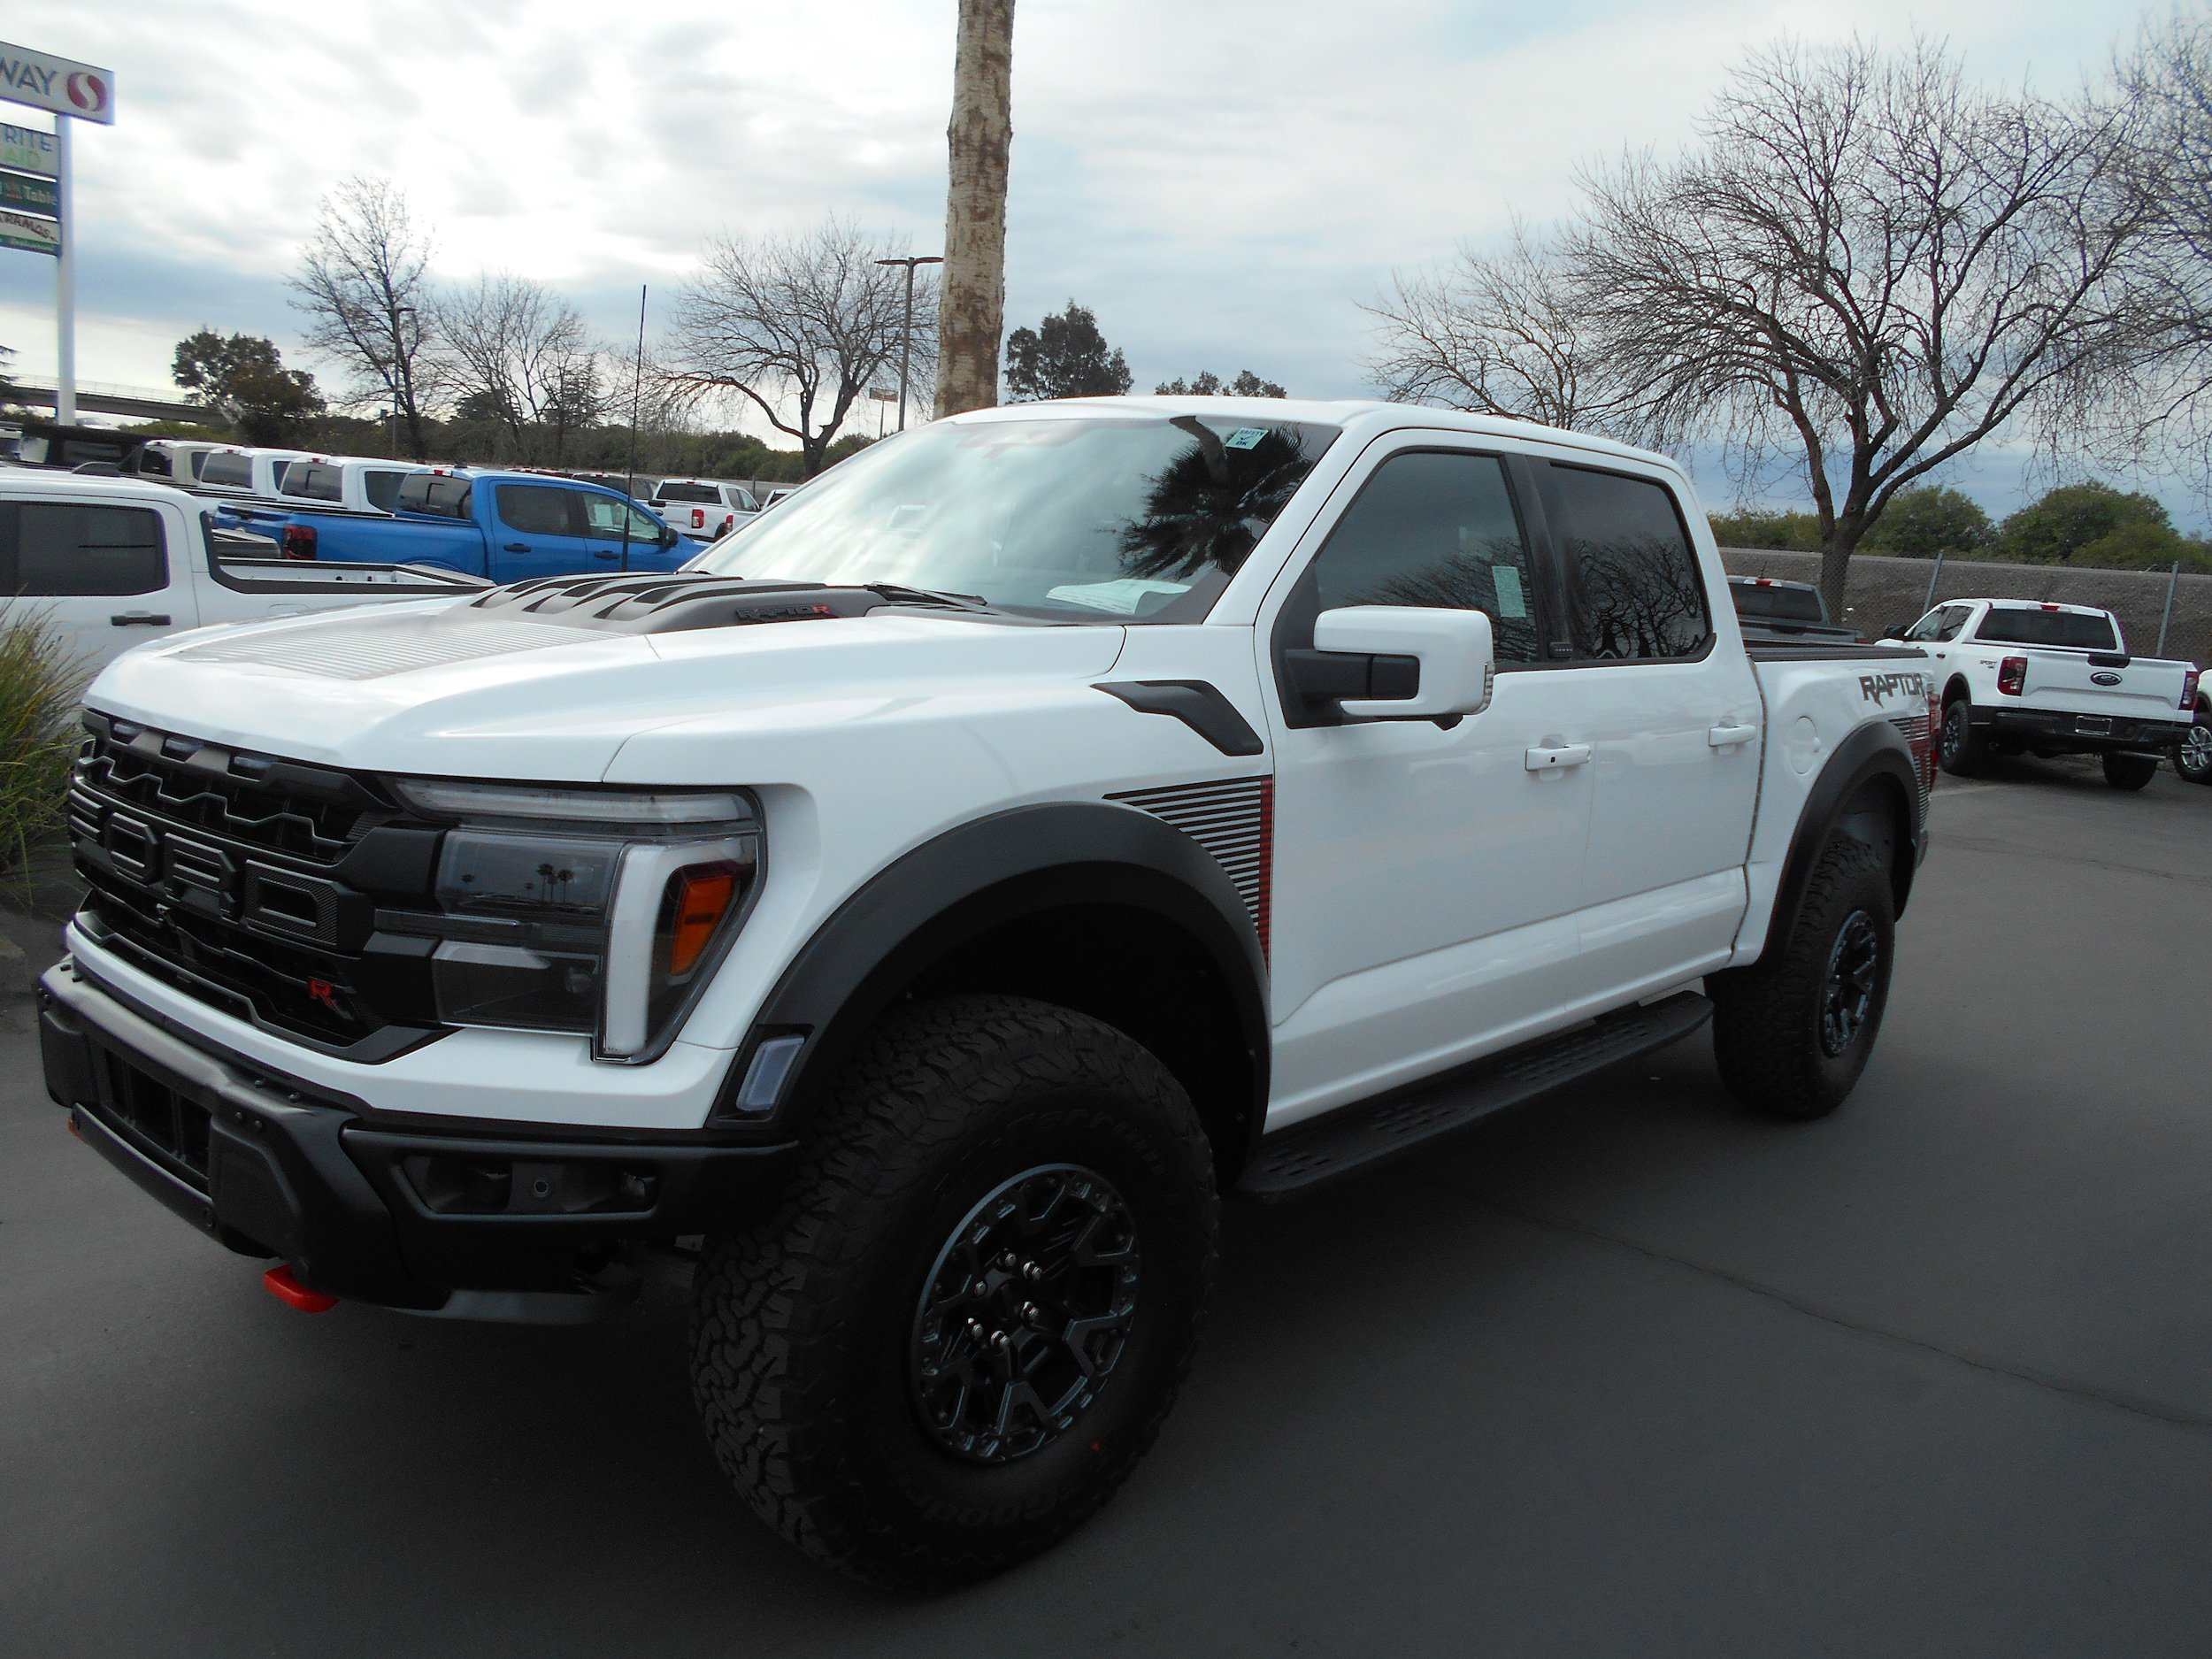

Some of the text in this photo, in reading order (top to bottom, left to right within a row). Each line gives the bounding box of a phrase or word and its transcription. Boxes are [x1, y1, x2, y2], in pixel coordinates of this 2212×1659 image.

[4, 125, 53, 152] RITE
[1858, 672, 1928, 709] RAPTOR
[68, 787, 345, 949] FORD
